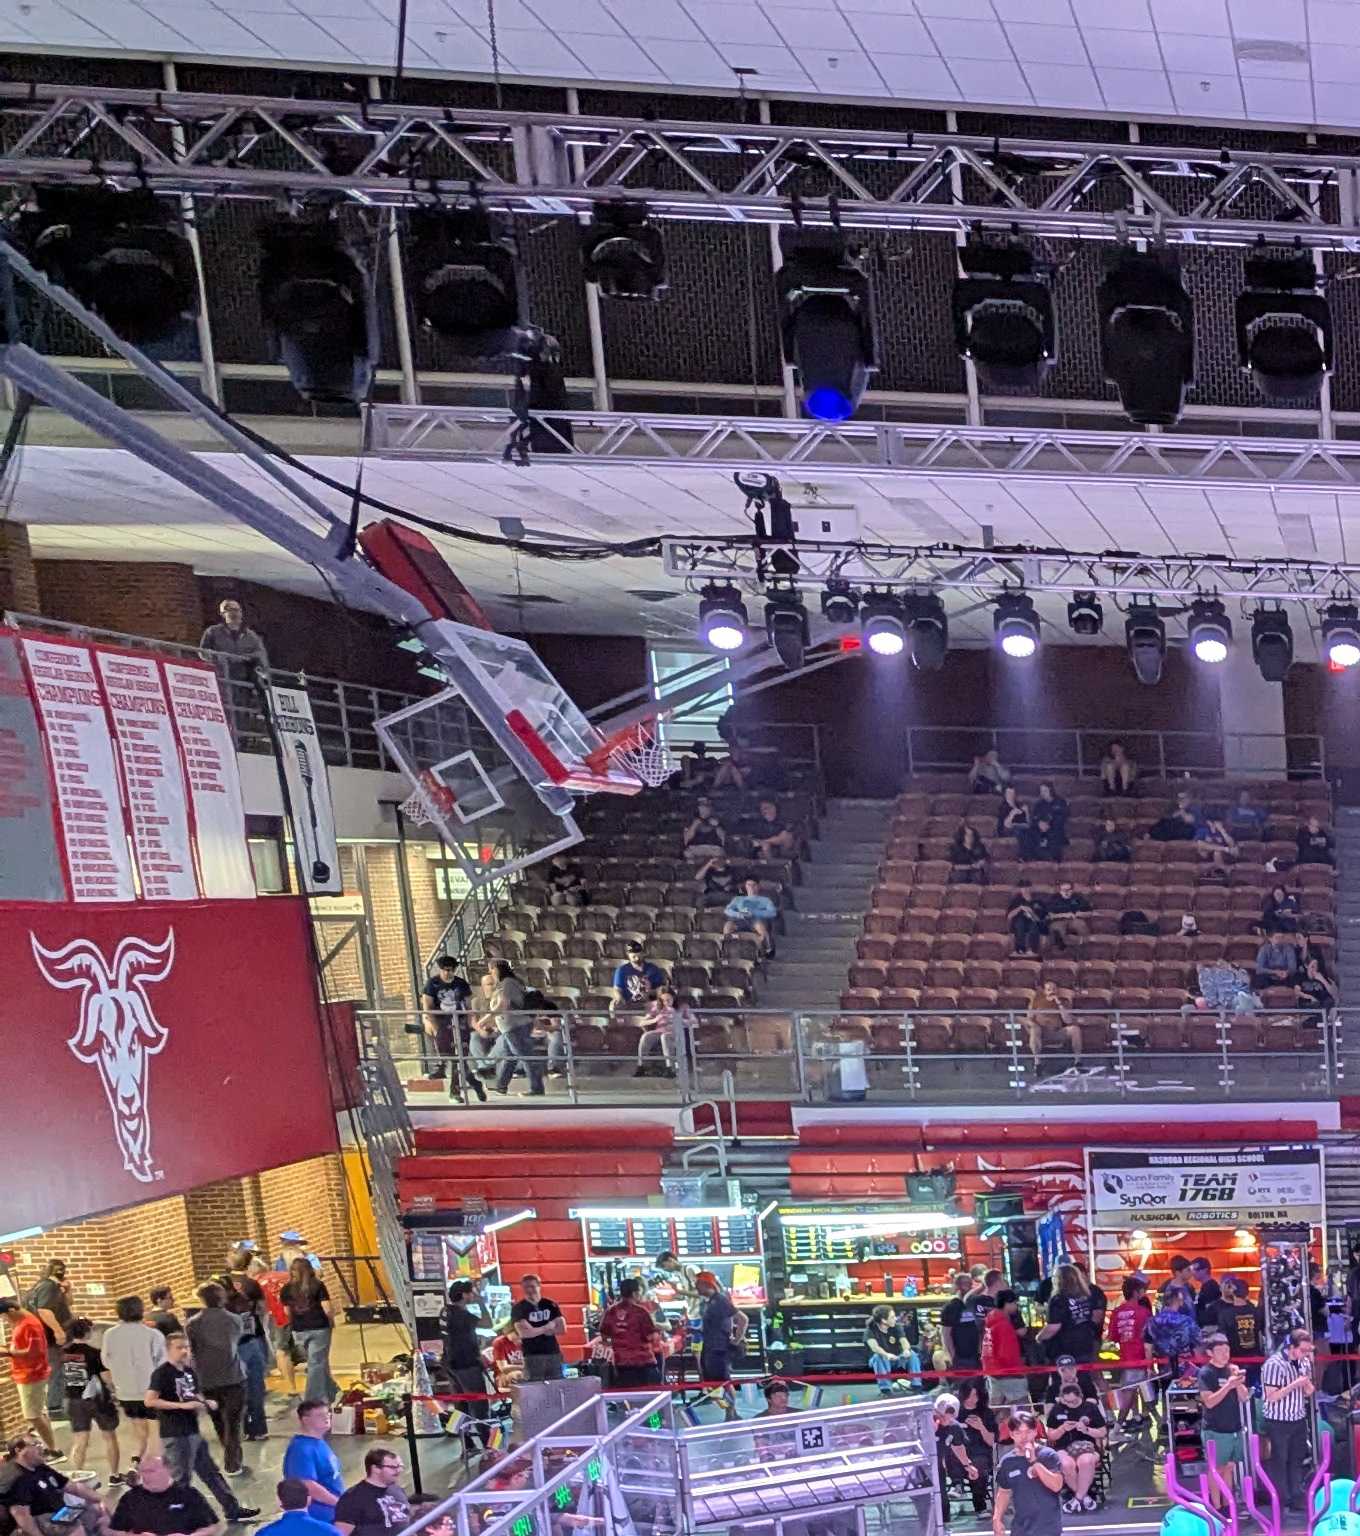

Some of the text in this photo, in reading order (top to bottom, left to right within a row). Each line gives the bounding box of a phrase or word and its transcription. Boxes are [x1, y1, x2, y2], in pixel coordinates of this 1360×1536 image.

[1183, 1155, 1218, 1164] REGIONAL
[1237, 1154, 1265, 1163] SCHOOL
[1125, 1173, 1175, 1184] Dunn Family
[1179, 1173, 1239, 1187] TEAM
[1119, 1193, 1168, 1208] SynQor
[1178, 1188, 1236, 1203] 1768
[1130, 1213, 1181, 1221] NASHOBA
[1188, 1211, 1238, 1220] ROBOTICS
